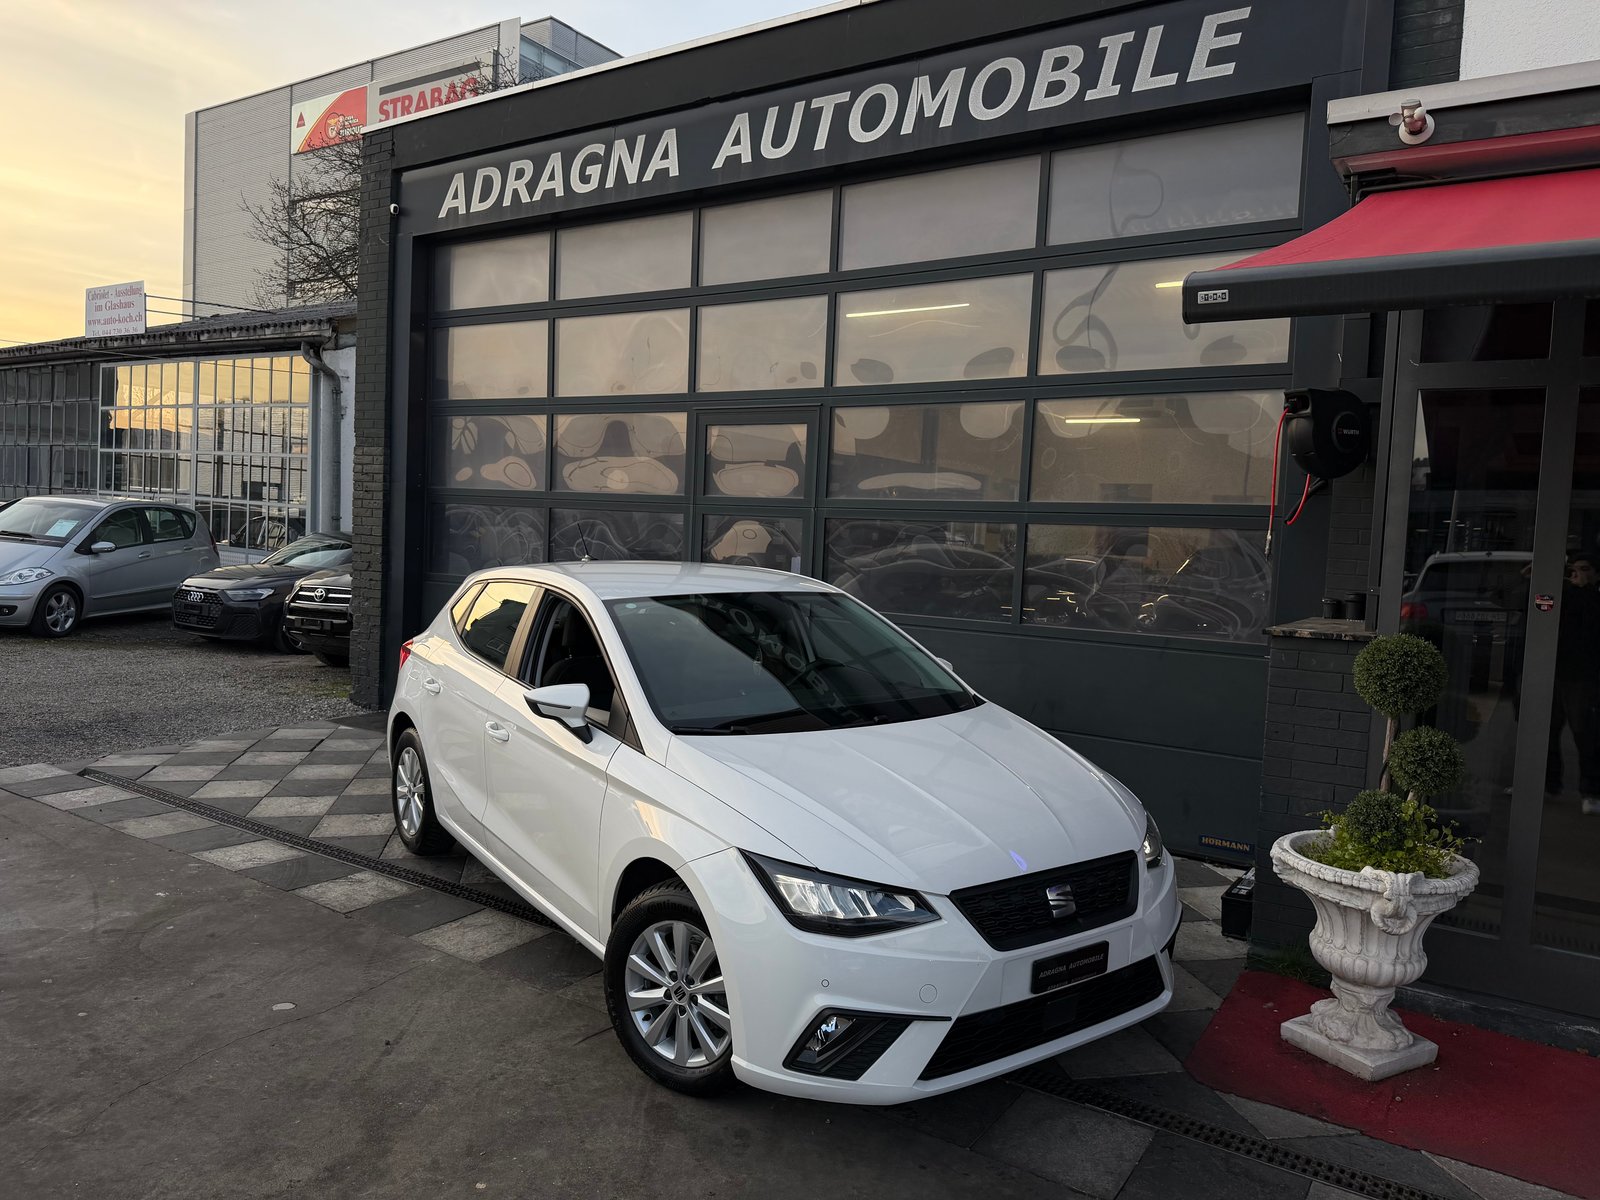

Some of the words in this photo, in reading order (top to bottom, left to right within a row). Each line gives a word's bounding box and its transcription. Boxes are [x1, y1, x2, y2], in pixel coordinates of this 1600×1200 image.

[378, 77, 480, 123] STRABAG
[438, 128, 680, 219] ADRAGNA
[711, 6, 1252, 170] AUTOMOBILE
[94, 302, 103, 312] im
[104, 299, 135, 311] Glashaus
[88, 312, 143, 325] www.auto-koch.ch
[1068, 954, 1105, 970] AUTOMOBILE
